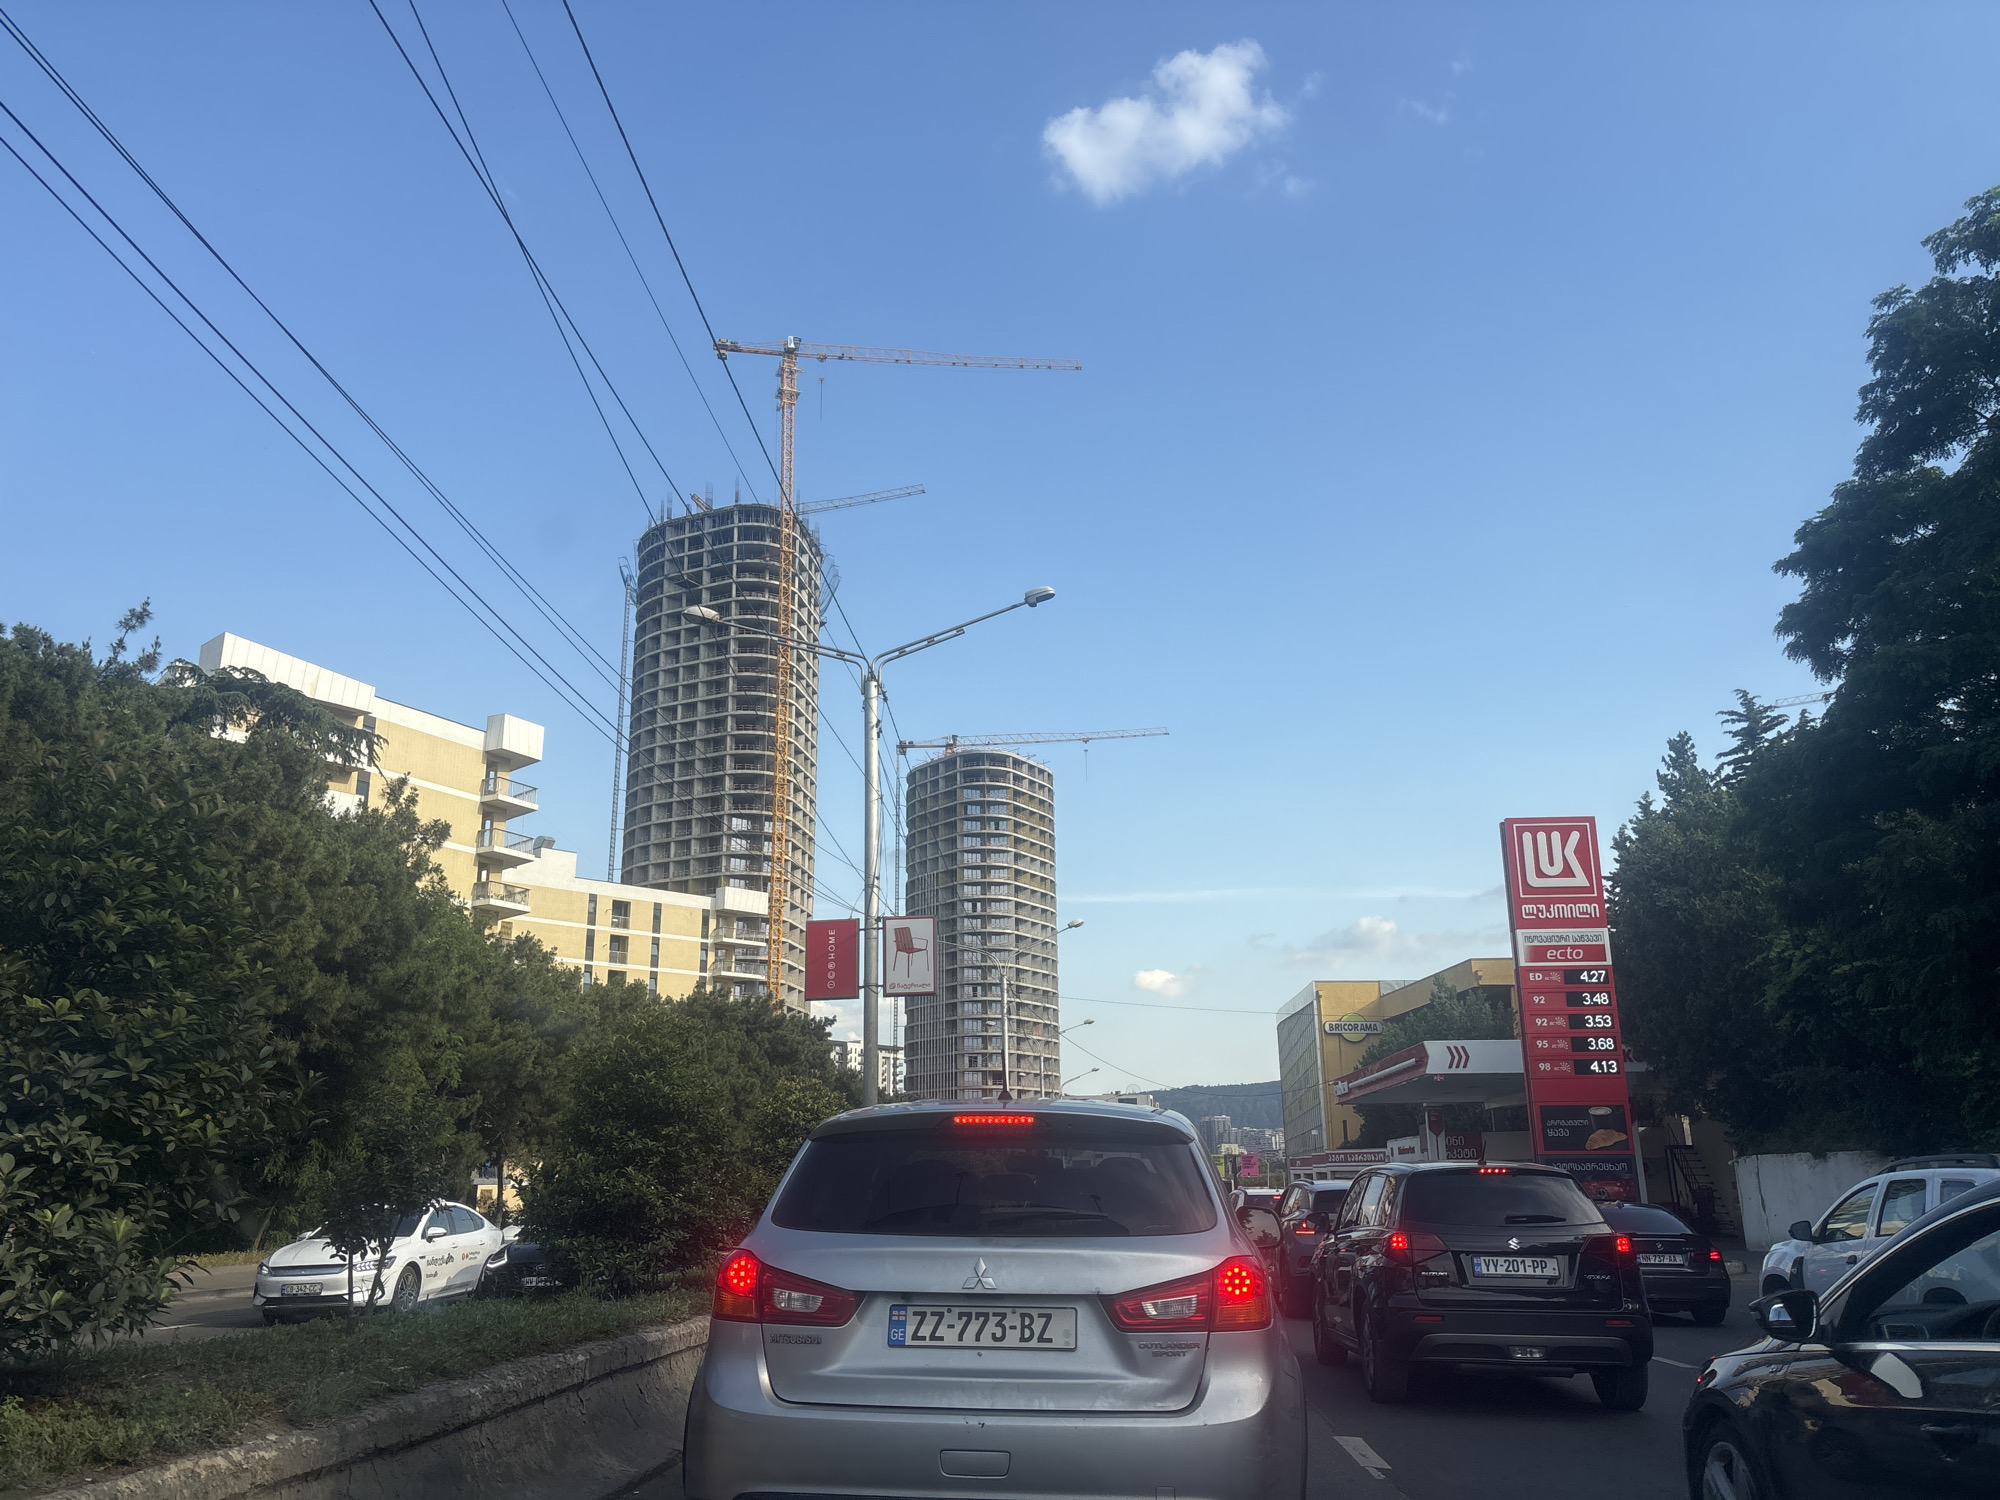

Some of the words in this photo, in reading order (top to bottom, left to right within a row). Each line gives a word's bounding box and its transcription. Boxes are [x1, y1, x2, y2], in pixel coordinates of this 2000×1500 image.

[1521, 903, 1600, 919] ლუკოილი
[828, 929, 836, 960] HOME
[1524, 934, 1570, 944] ინოვაციური
[1571, 934, 1603, 943] საწვავი
[1546, 946, 1584, 959] ecto
[1529, 973, 1543, 981] ED
[1580, 970, 1606, 982] 4.27
[1533, 996, 1546, 1004] 92
[1582, 992, 1609, 1005] 3.48
[1328, 1023, 1379, 1032] BRICORAMA
[1535, 1018, 1548, 1026] 92
[1584, 1015, 1612, 1028] 3.53
[1536, 1040, 1549, 1049] 95
[1587, 1038, 1615, 1050] 3.68
[1538, 1063, 1551, 1071] 98
[1590, 1061, 1618, 1073] 4.13
[1547, 1128, 1570, 1137] ყავა
[1483, 1258, 1548, 1274] YY-201-PP
[890, 1328, 905, 1341] GE
[911, 1310, 1054, 1344] ZZ-773-BZ
[769, 1333, 822, 1345] MITSUBISHI
[1138, 1341, 1201, 1350] OUTLANDER
[1151, 1350, 1188, 1358] SPORT
